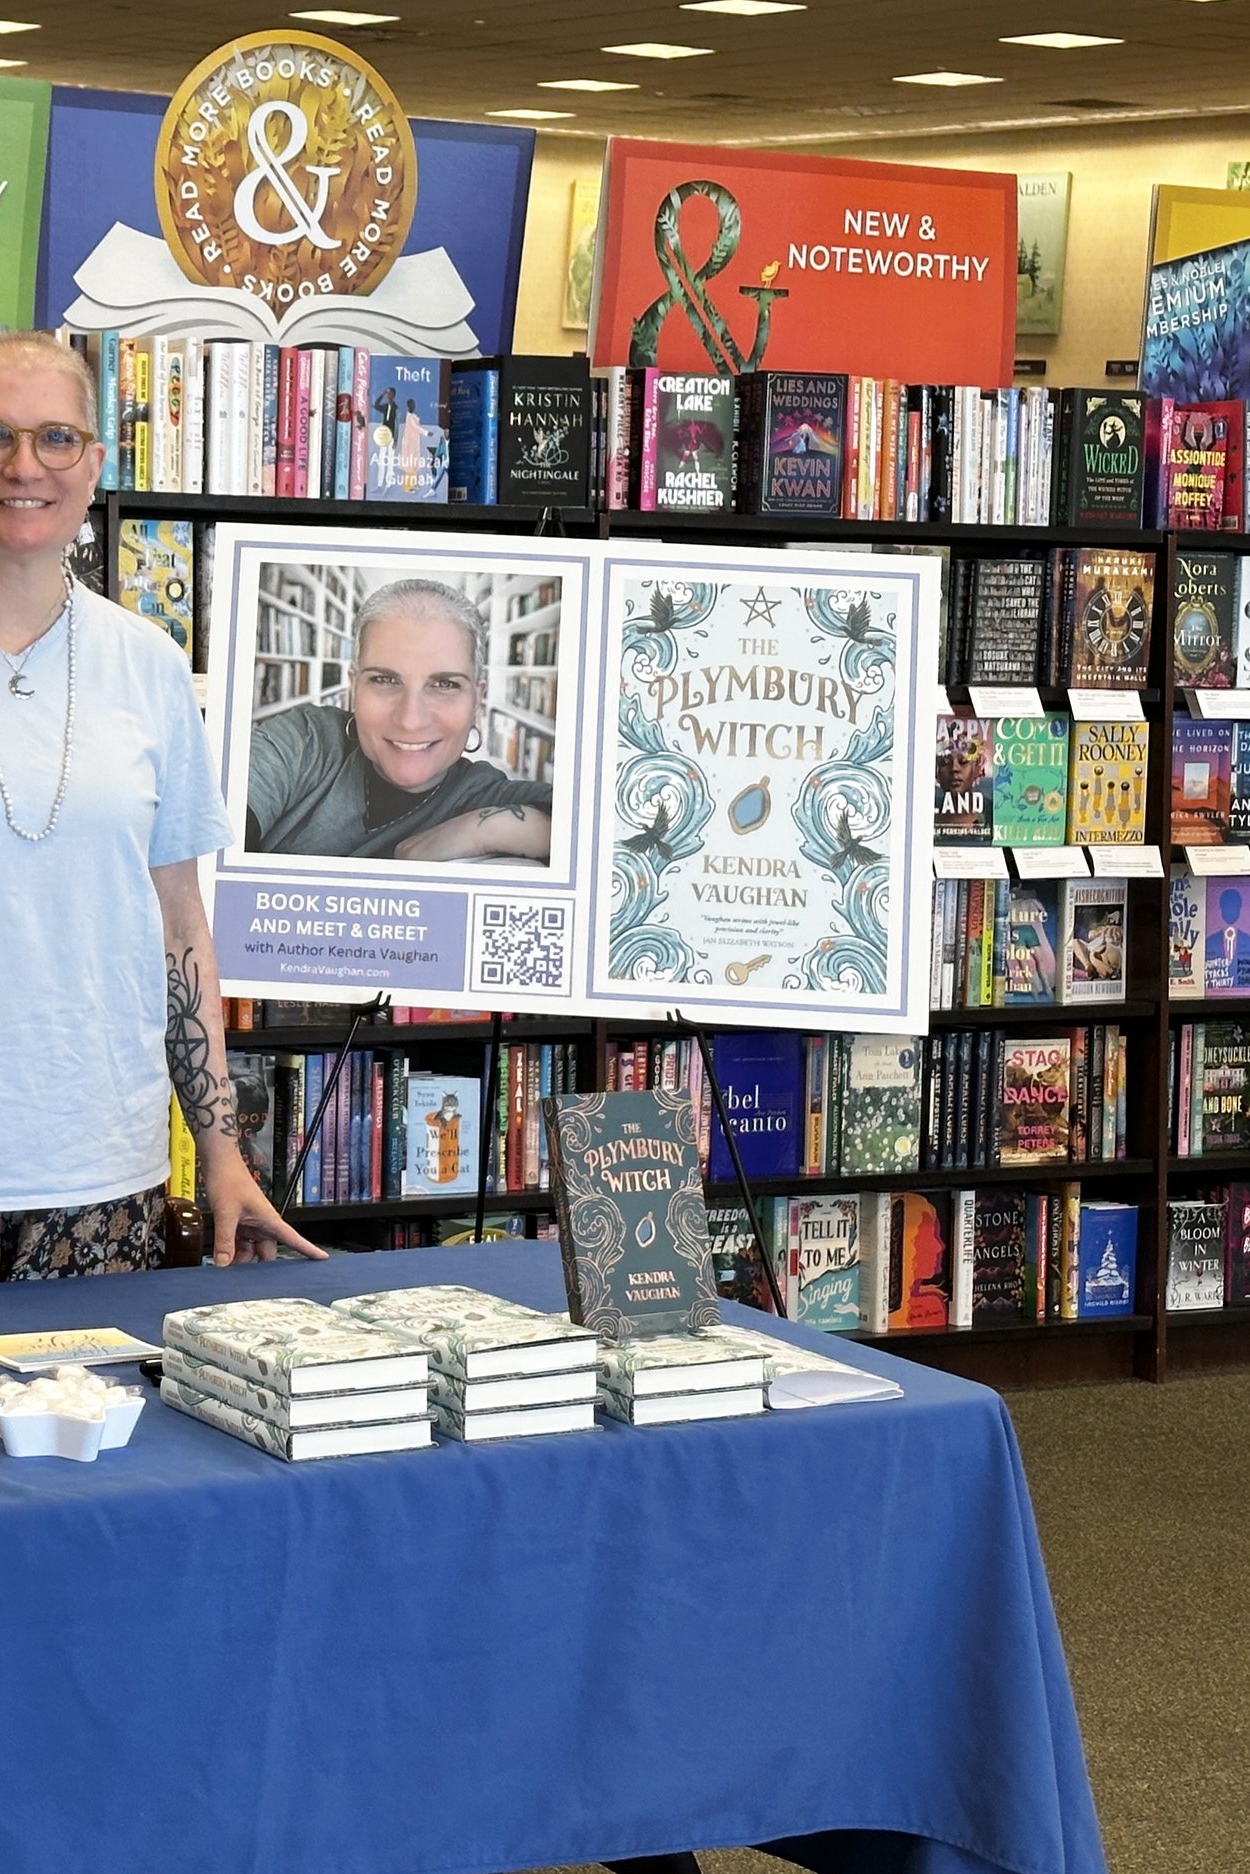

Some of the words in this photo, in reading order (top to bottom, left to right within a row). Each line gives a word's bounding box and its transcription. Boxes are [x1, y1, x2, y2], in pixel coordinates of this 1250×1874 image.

[237, 59, 332, 90] BOOKS
[181, 84, 231, 167] MORE
[355, 104, 393, 185] READ
[181, 181, 222, 263] READ
[844, 208, 910, 239] NEW
[918, 215, 937, 241] &
[340, 199, 390, 277] MORE
[788, 243, 990, 283] NOTEWORTHY
[242, 273, 334, 302] BOOKS
[395, 366, 431, 383] Theft
[658, 376, 730, 396] CREATION
[777, 379, 806, 393] LIES
[809, 381, 836, 394] AND
[514, 393, 581, 408] KRISTIN
[676, 394, 713, 411] LAKE
[299, 407, 308, 442] GOOD
[510, 412, 583, 427] HANNAH
[298, 446, 307, 471] LIFE
[774, 457, 831, 477] KEVIN
[1084, 443, 1138, 475] WICKED
[510, 468, 580, 481] NIGHTINGALE
[666, 472, 718, 489] RACHEL
[1173, 474, 1216, 489] MONIQUE
[771, 478, 831, 498] KWAN
[658, 489, 724, 507] KUSHNER
[1174, 491, 1213, 507] ROFFEY
[1083, 565, 1154, 576] MURAKAMI
[1097, 556, 1144, 567] HARUKI
[1176, 557, 1217, 579] Nora
[1005, 598, 1025, 608] SAVED
[1027, 597, 1039, 608] THE
[1013, 607, 1039, 618] LIBRARY
[738, 637, 779, 656] THE
[649, 665, 866, 725] PLYMBURY
[678, 713, 824, 761] WITCH
[1089, 725, 1140, 743] SALLY
[1079, 744, 1147, 762] ROONEY
[1190, 745, 1230, 753] HORIZON
[1075, 831, 1144, 843] INTERMEZZO
[702, 854, 802, 879] KENDRA
[691, 882, 808, 908] VAUGHAN
[256, 892, 320, 913] BOOK
[325, 896, 421, 918] SIGNING
[250, 918, 291, 934] AND
[296, 920, 346, 938] MEET
[350, 922, 363, 938] &
[367, 923, 427, 942] GREET
[245, 942, 274, 955] with
[277, 942, 323, 957] Author
[327, 944, 377, 960] Kendra
[381, 947, 439, 964] Vaughan
[855, 1071, 873, 1081] Ann
[876, 1069, 910, 1081] Patchett
[622, 1122, 642, 1133] THE
[416, 1146, 470, 1158] Prescribe
[1018, 1138, 1054, 1148] PETERS
[584, 1139, 686, 1177] PLYMBURY
[601, 1168, 671, 1193] WITCH
[975, 1211, 1019, 1227] STONE
[803, 1219, 832, 1240] TELL
[835, 1218, 850, 1239] IT
[1180, 1227, 1220, 1240] BLOOM
[804, 1249, 820, 1268] TO
[827, 1247, 846, 1266] ME
[975, 1245, 1020, 1261] ANGELS
[1195, 1243, 1206, 1256] IN
[1178, 1259, 1220, 1271] WINTER
[628, 1271, 675, 1286] KENDRA
[974, 1281, 1001, 1292] HELENA
[1004, 1281, 1019, 1290] RHO
